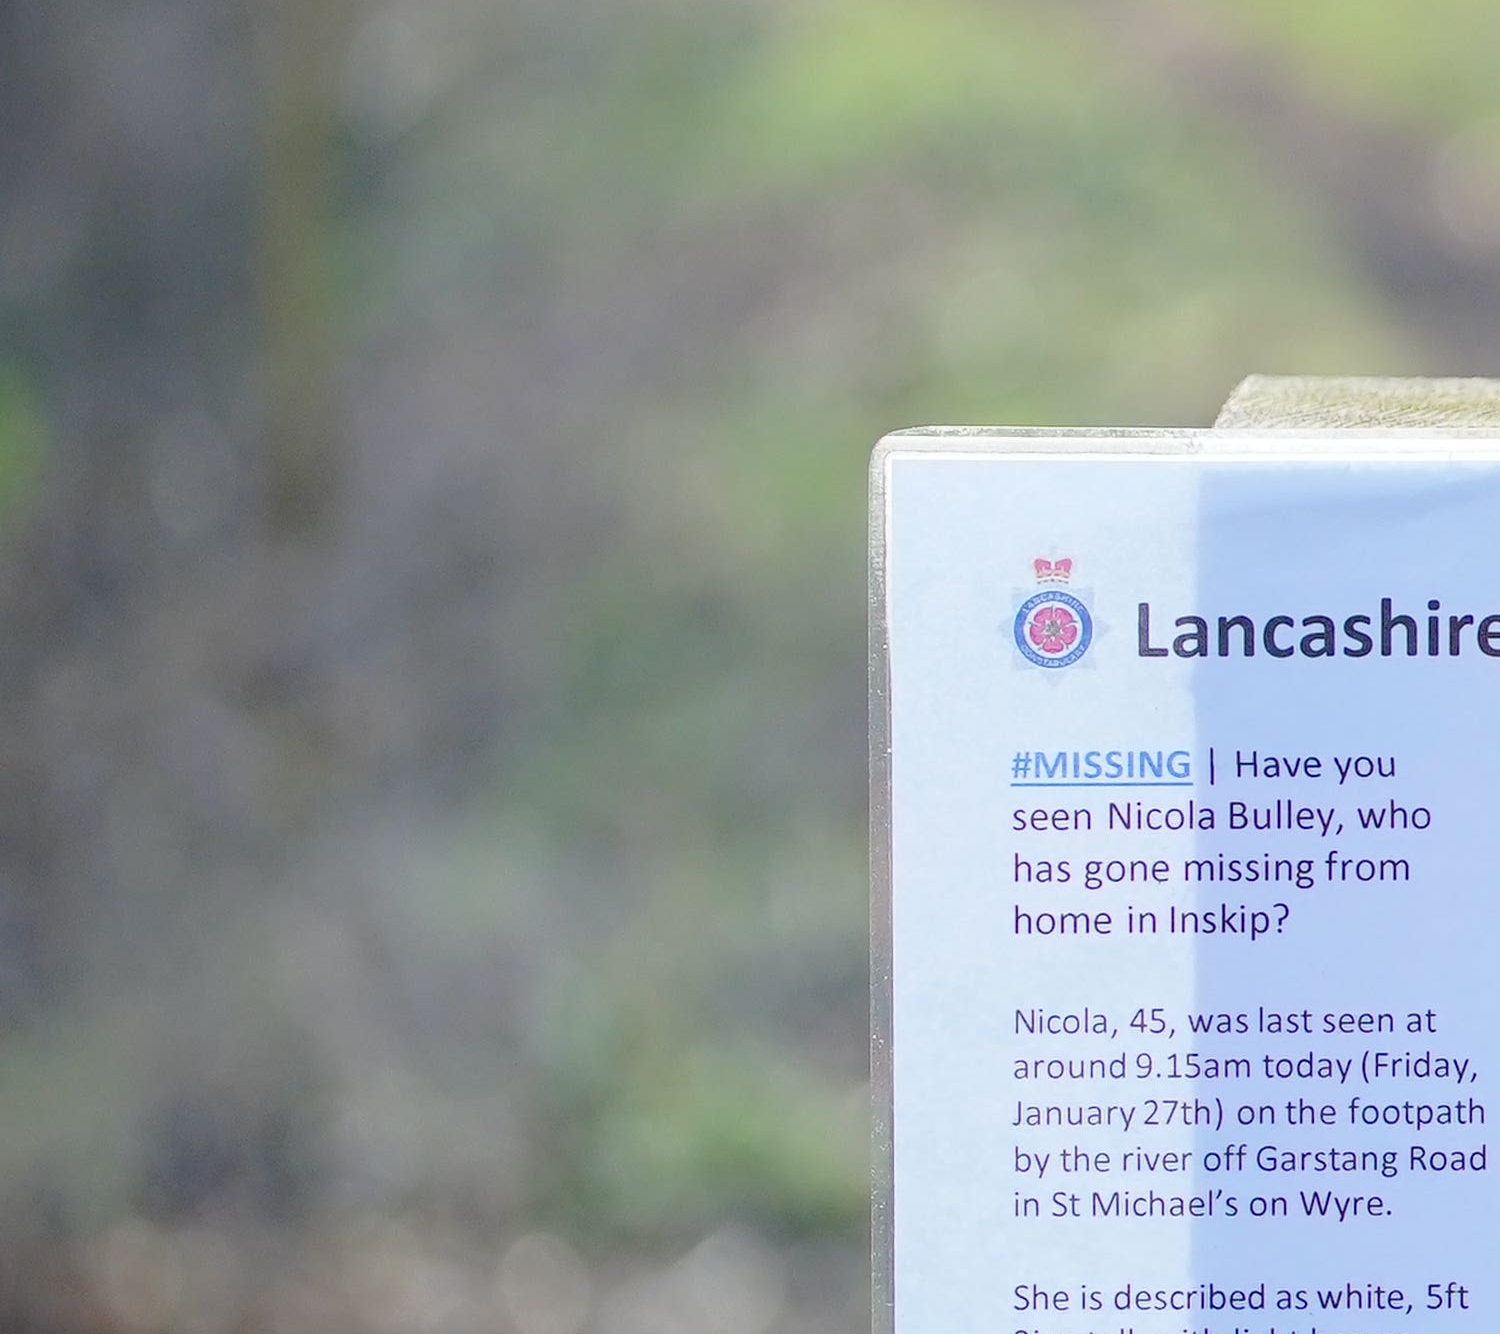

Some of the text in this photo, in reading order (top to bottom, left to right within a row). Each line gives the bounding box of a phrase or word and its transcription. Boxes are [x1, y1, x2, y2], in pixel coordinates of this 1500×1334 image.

[1010, 751, 1193, 787] #MISSING
[1236, 750, 1322, 778] Have
[1333, 756, 1395, 785] you
[1012, 799, 1431, 837] seen Nicola Bulley, who
[1014, 850, 1409, 890] has gone missing from
[1015, 903, 1289, 941] home in Inskip?
[1016, 1006, 1437, 1039] Nicola, 45, was last seen at
[1014, 1050, 1477, 1084] around 9.15am today (Friday,
[1012, 1097, 1484, 1132] January 27th) on the footpath
[1015, 1144, 1486, 1179] by the river off Garstang Road
[1014, 1282, 1469, 1315] She is described as white, 5ft
